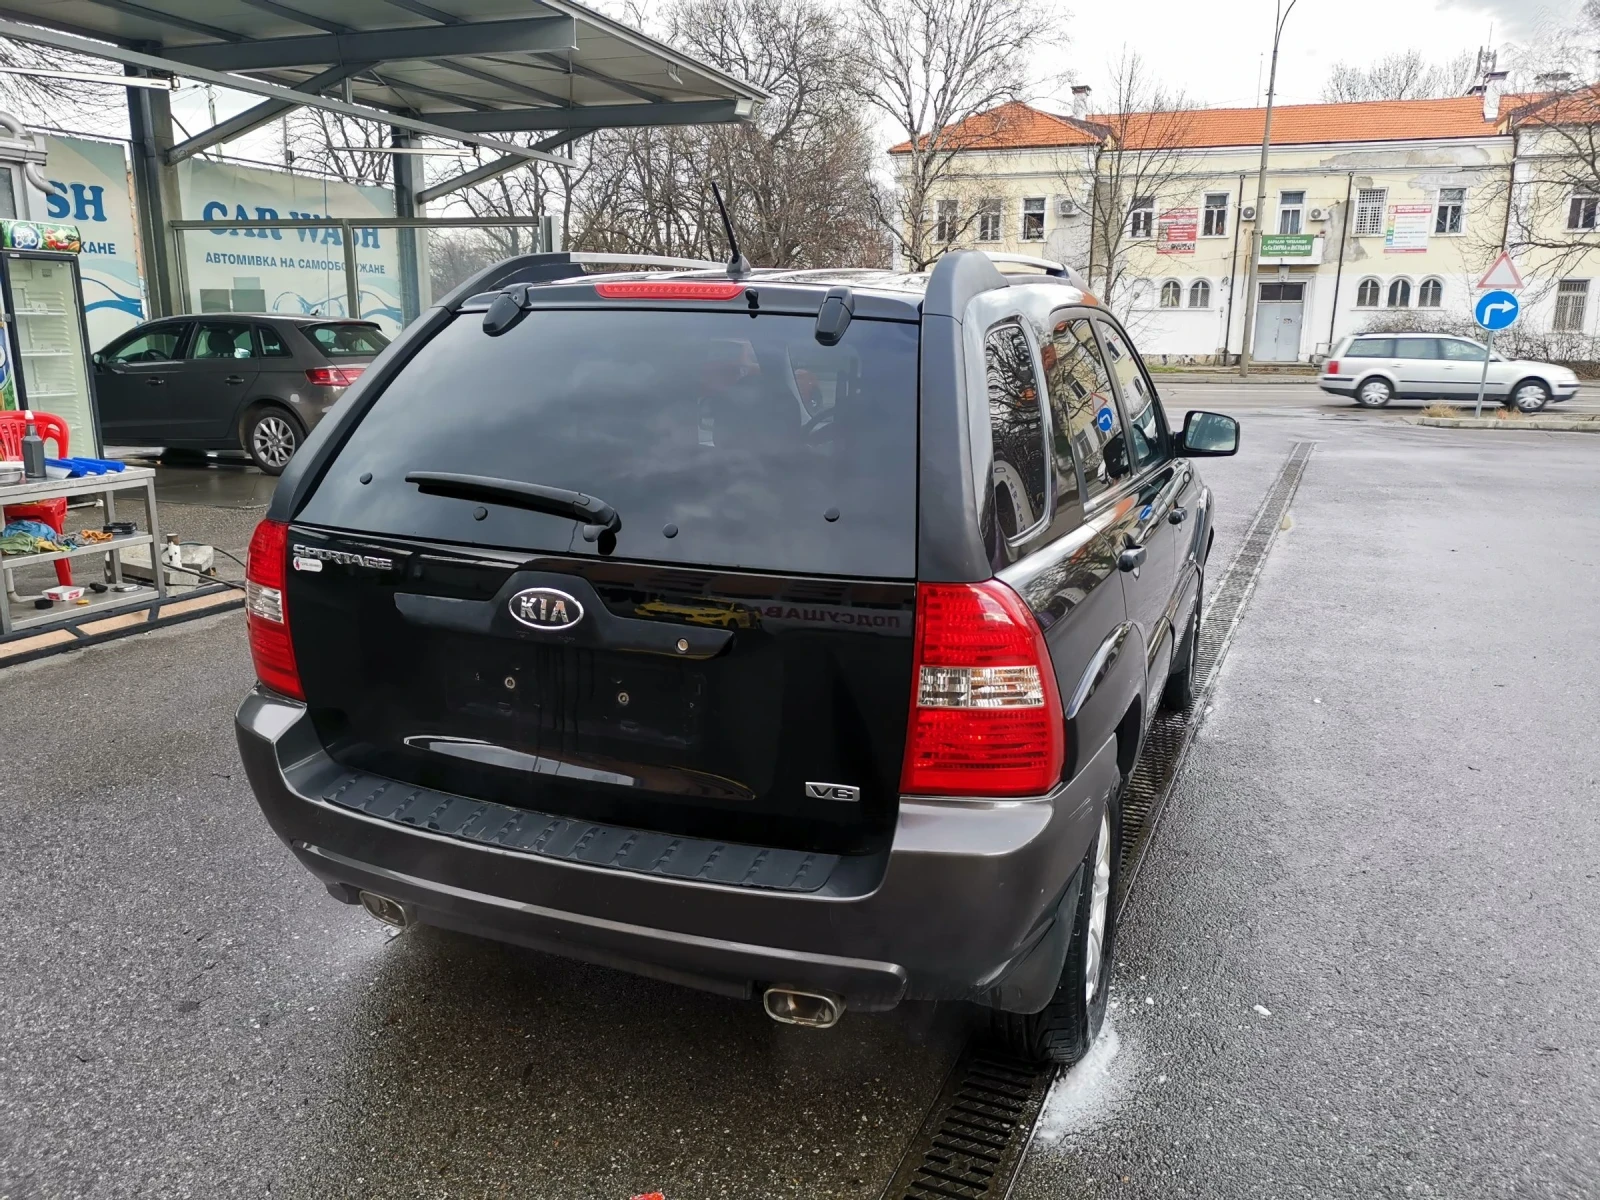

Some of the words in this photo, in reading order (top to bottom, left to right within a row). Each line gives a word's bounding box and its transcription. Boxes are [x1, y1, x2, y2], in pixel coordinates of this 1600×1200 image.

[203, 201, 283, 241] CAR
[289, 211, 381, 249] WAH
[205, 251, 278, 268] АВТОМИВКА
[280, 257, 296, 269] НА
[298, 258, 386, 275] САМООБСЖАНЕ
[293, 543, 393, 571] SPORTAGE
[520, 595, 570, 623] KIA
[808, 784, 855, 801] V6
